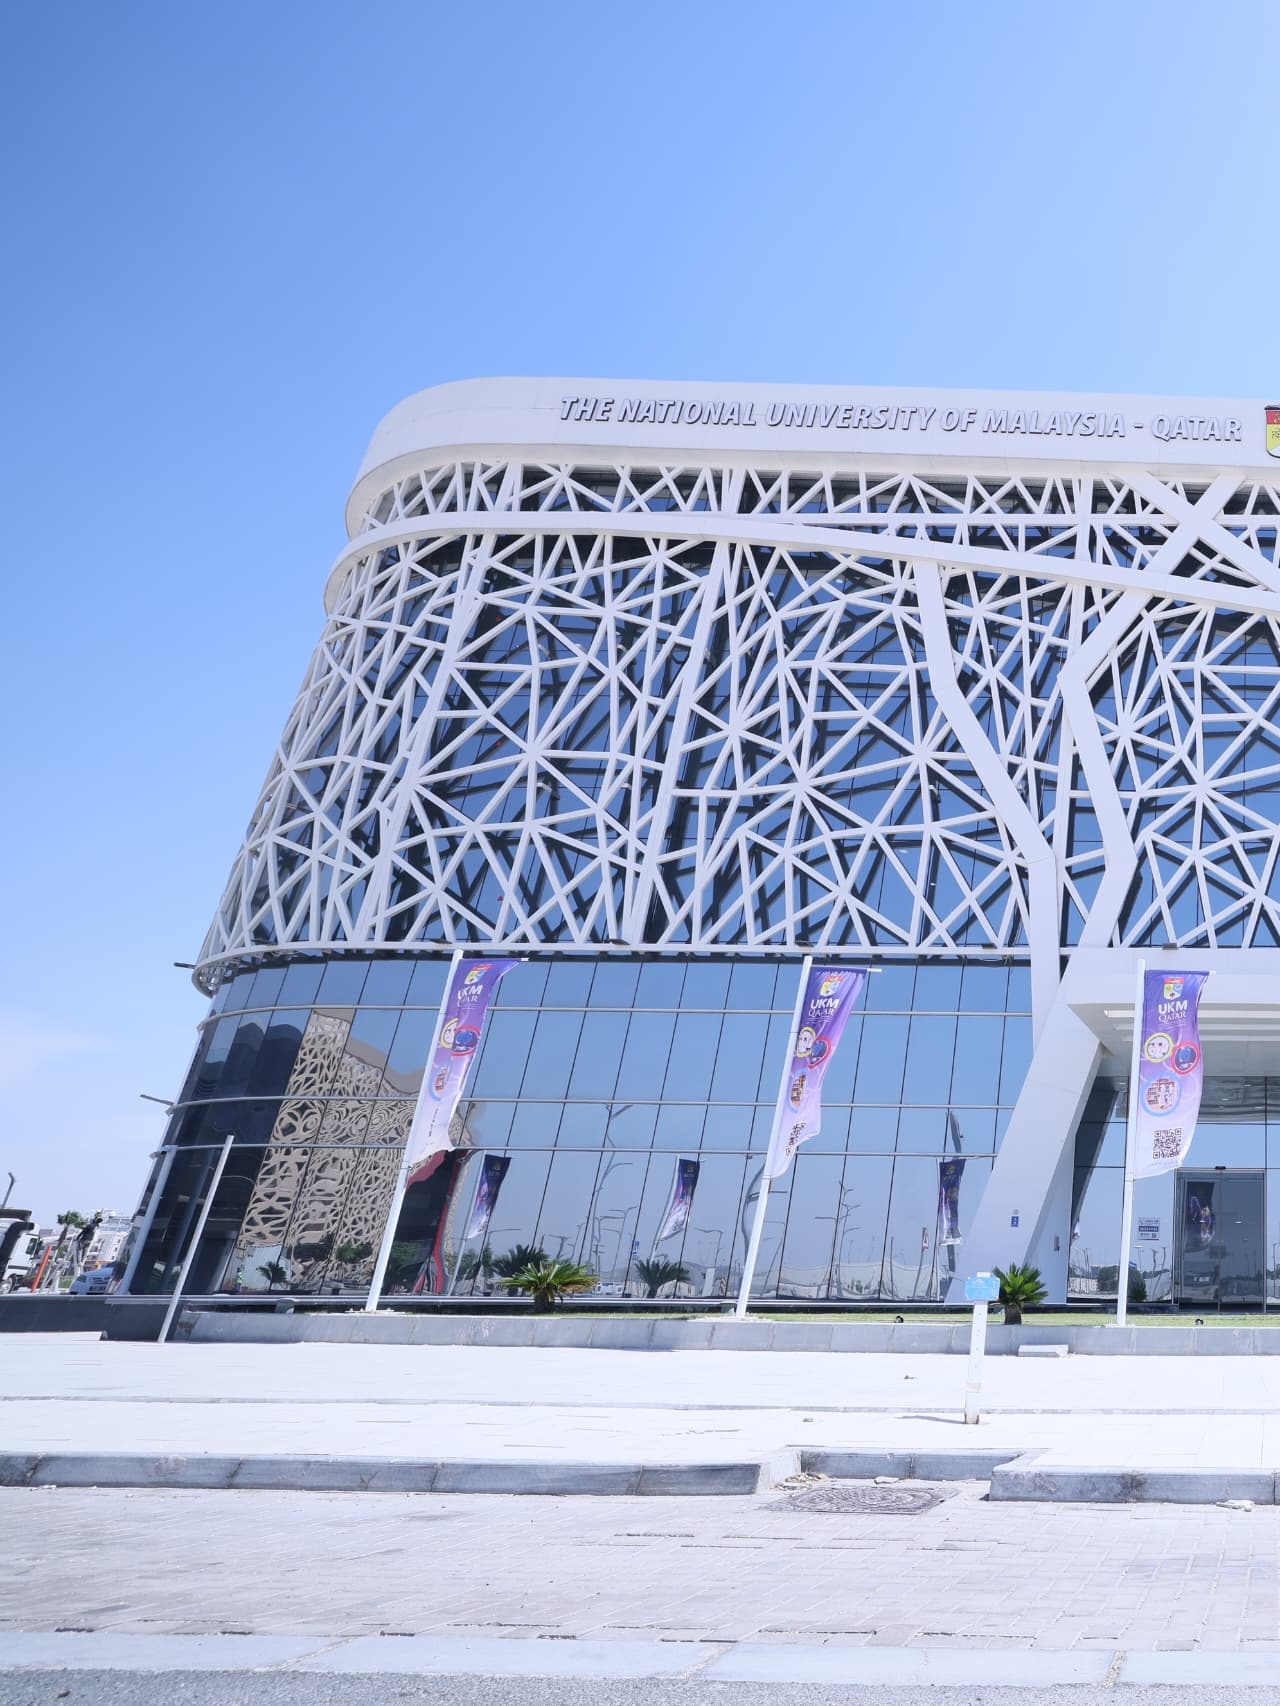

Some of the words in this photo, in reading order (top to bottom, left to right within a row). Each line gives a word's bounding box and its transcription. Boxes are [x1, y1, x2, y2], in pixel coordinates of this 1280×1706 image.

[560, 397, 614, 421] THE
[617, 399, 756, 426] NATIONAL
[766, 402, 936, 430] UNIVERSITY
[941, 407, 977, 432] OF
[982, 409, 1126, 437] MALAYSIA
[1151, 415, 1242, 442] QATAR
[810, 997, 840, 1009] UKM
[1158, 999, 1188, 1014] UKM
[1158, 1011, 1187, 1023] QATAR
